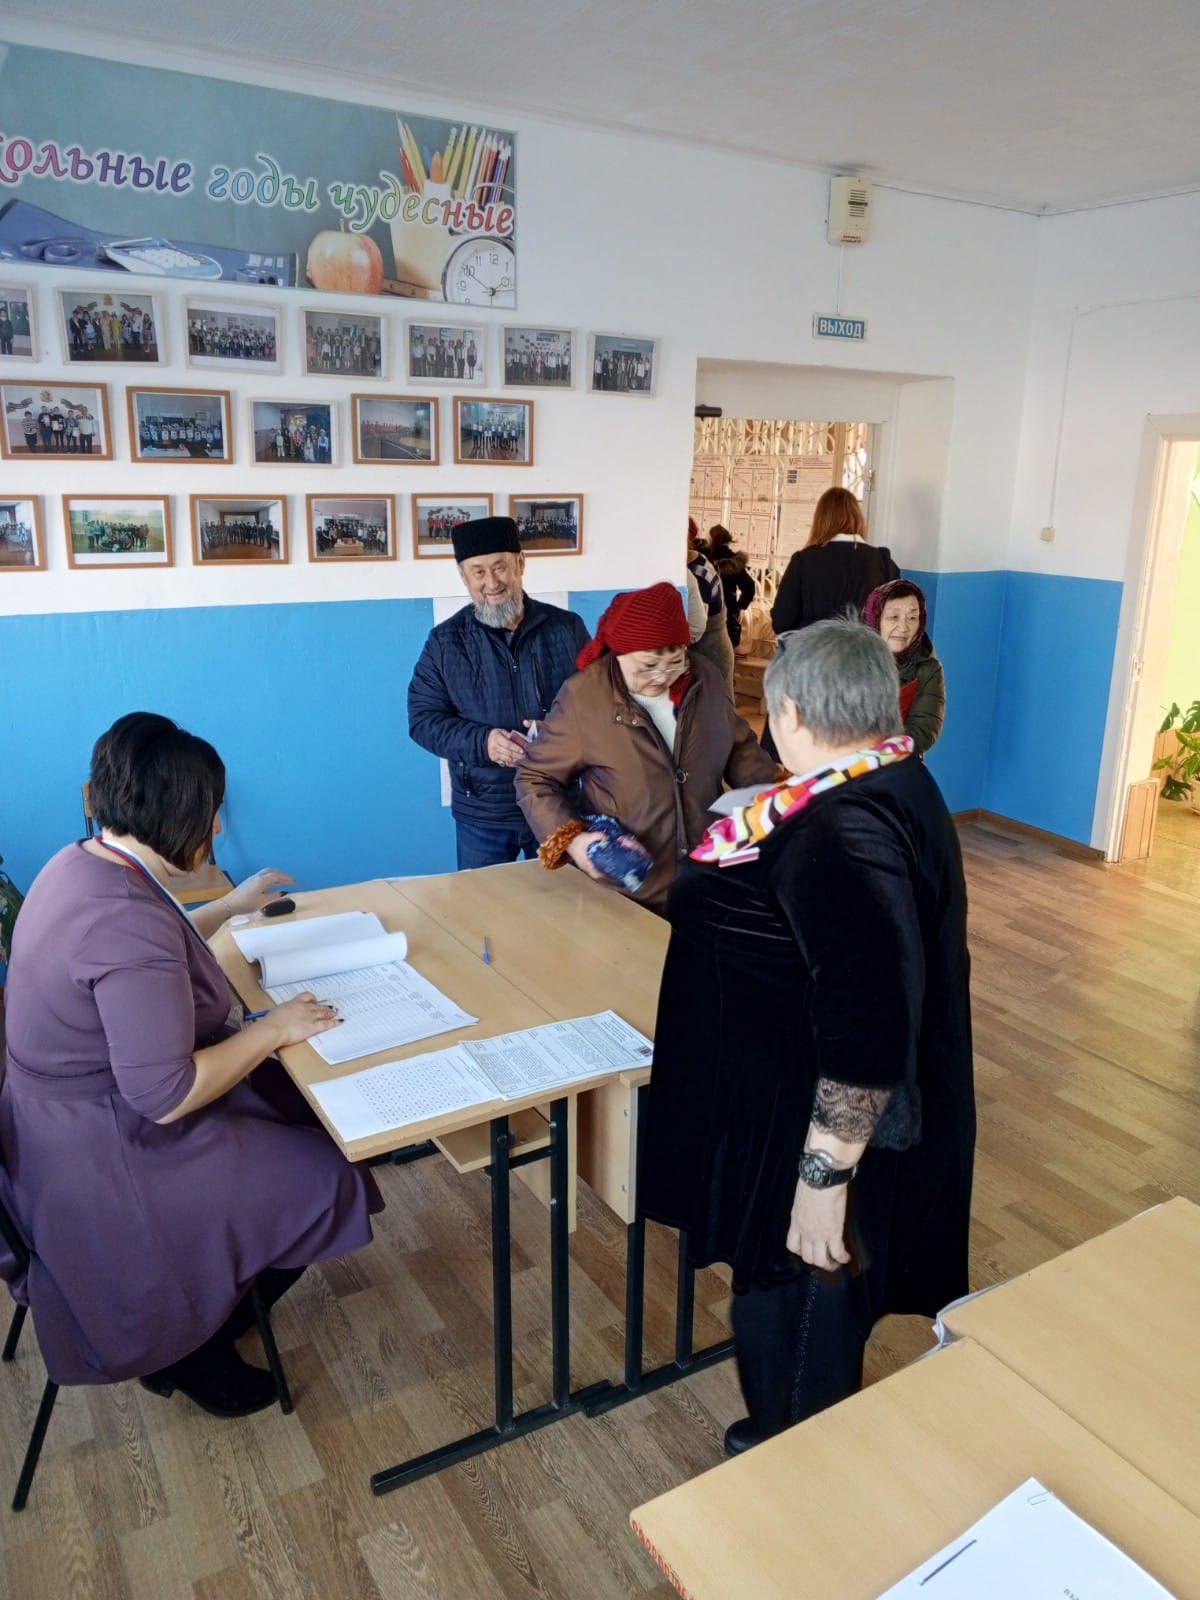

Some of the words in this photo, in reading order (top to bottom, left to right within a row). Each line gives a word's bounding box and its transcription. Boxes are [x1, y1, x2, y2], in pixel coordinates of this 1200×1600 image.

[208, 155, 318, 210] годы
[329, 173, 513, 234] чудесные
[819, 319, 863, 338] ВЫХОД
